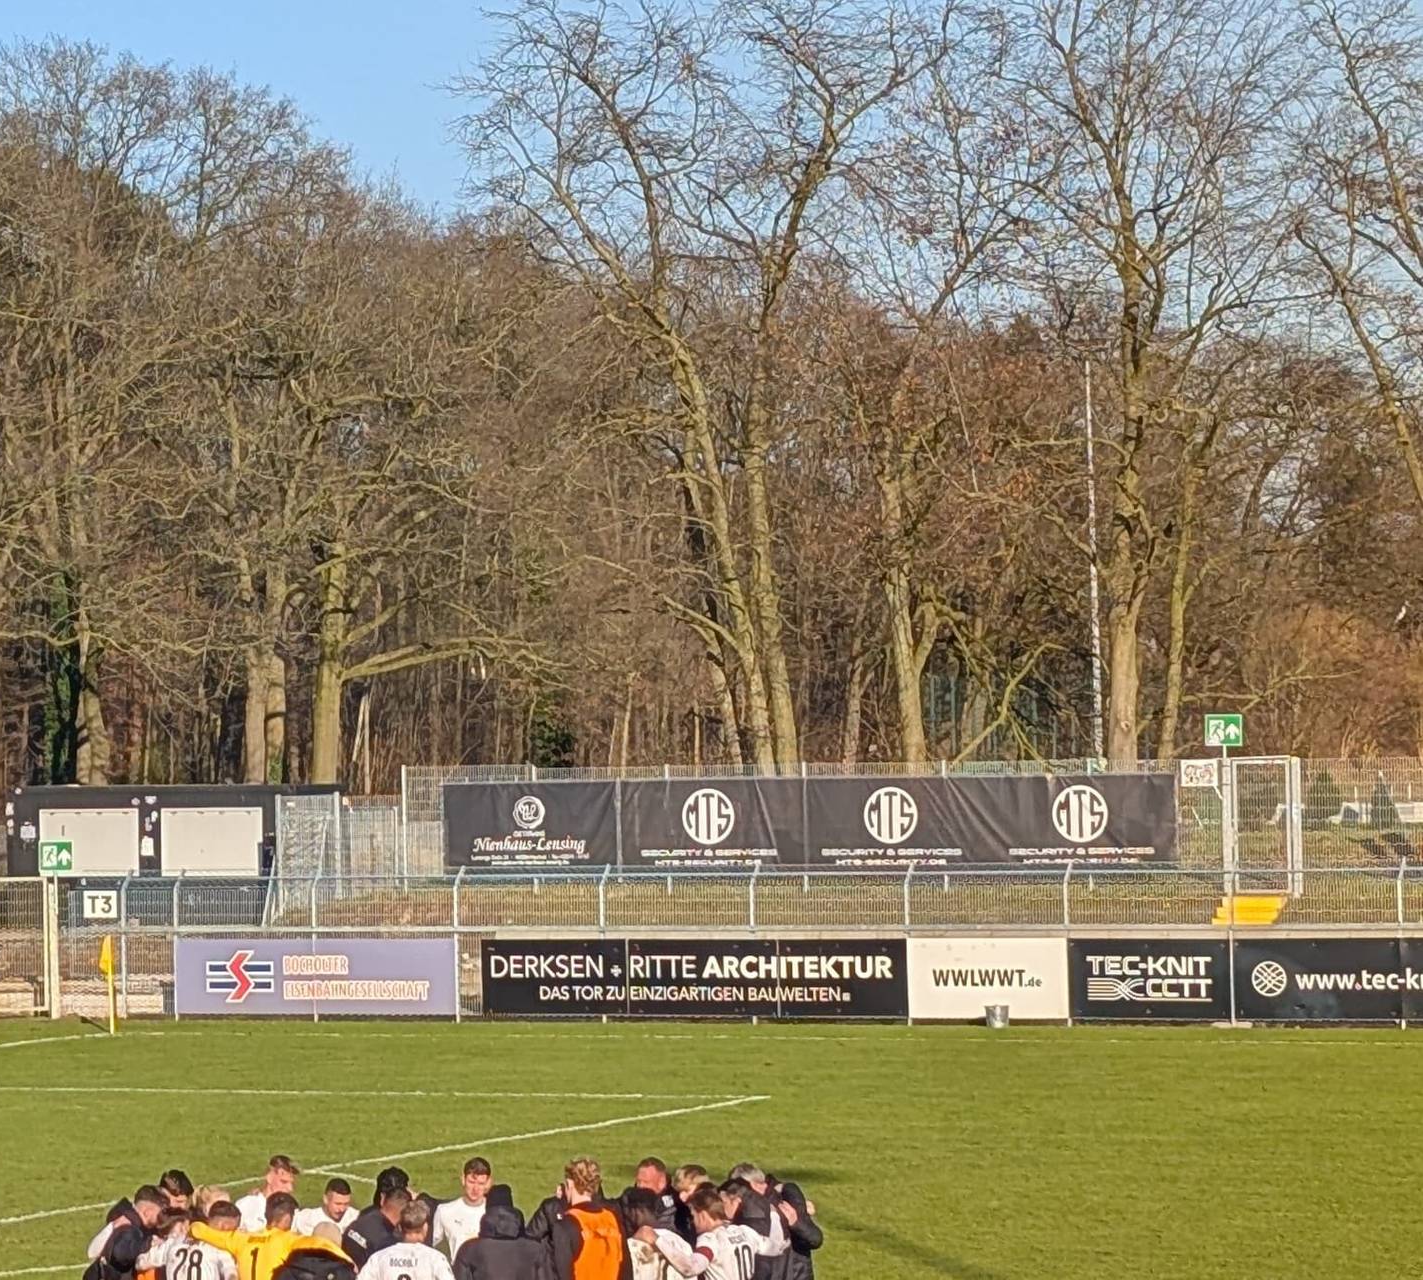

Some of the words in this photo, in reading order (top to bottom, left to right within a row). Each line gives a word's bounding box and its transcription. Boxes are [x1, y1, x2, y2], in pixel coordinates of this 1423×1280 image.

[683, 790, 733, 843] MTS
[865, 788, 916, 842] MTS
[1053, 786, 1107, 841] MTS
[473, 835, 586, 854] Nienhaus-Lensing
[641, 849, 702, 857] SECURITY
[704, 848, 713, 857] &
[715, 848, 777, 857] SERVICES
[821, 848, 884, 856] SECURITY
[886, 848, 895, 856] &
[897, 848, 963, 856] SERVICES
[1008, 848, 1074, 856] SECURITY
[1076, 847, 1086, 855] &
[1088, 846, 1155, 855] SERVICES
[87, 895, 112, 914] T3
[283, 955, 348, 975] BOCHOLTER
[490, 955, 604, 978] DERKSEN
[630, 955, 697, 979] RITTE
[702, 955, 893, 979] ARCHITEKTUR
[1086, 955, 1213, 976] TEC-KNIT
[932, 968, 1043, 988] WWLWWT.de
[1145, 978, 1213, 998] CCTT
[1295, 967, 1423, 991] www.tec-k
[283, 980, 429, 1001] EISENBAHNGESELLSCHAFT
[539, 985, 569, 1000] DAS
[572, 985, 603, 1000] TOR
[606, 985, 625, 1000] ZU
[630, 985, 744, 1001] EINZIGARTIGEN
[748, 986, 841, 1002] BAUWELTEN
[174, 1248, 203, 1280] 28
[250, 1247, 259, 1280] 1
[734, 1244, 753, 1280] 10
